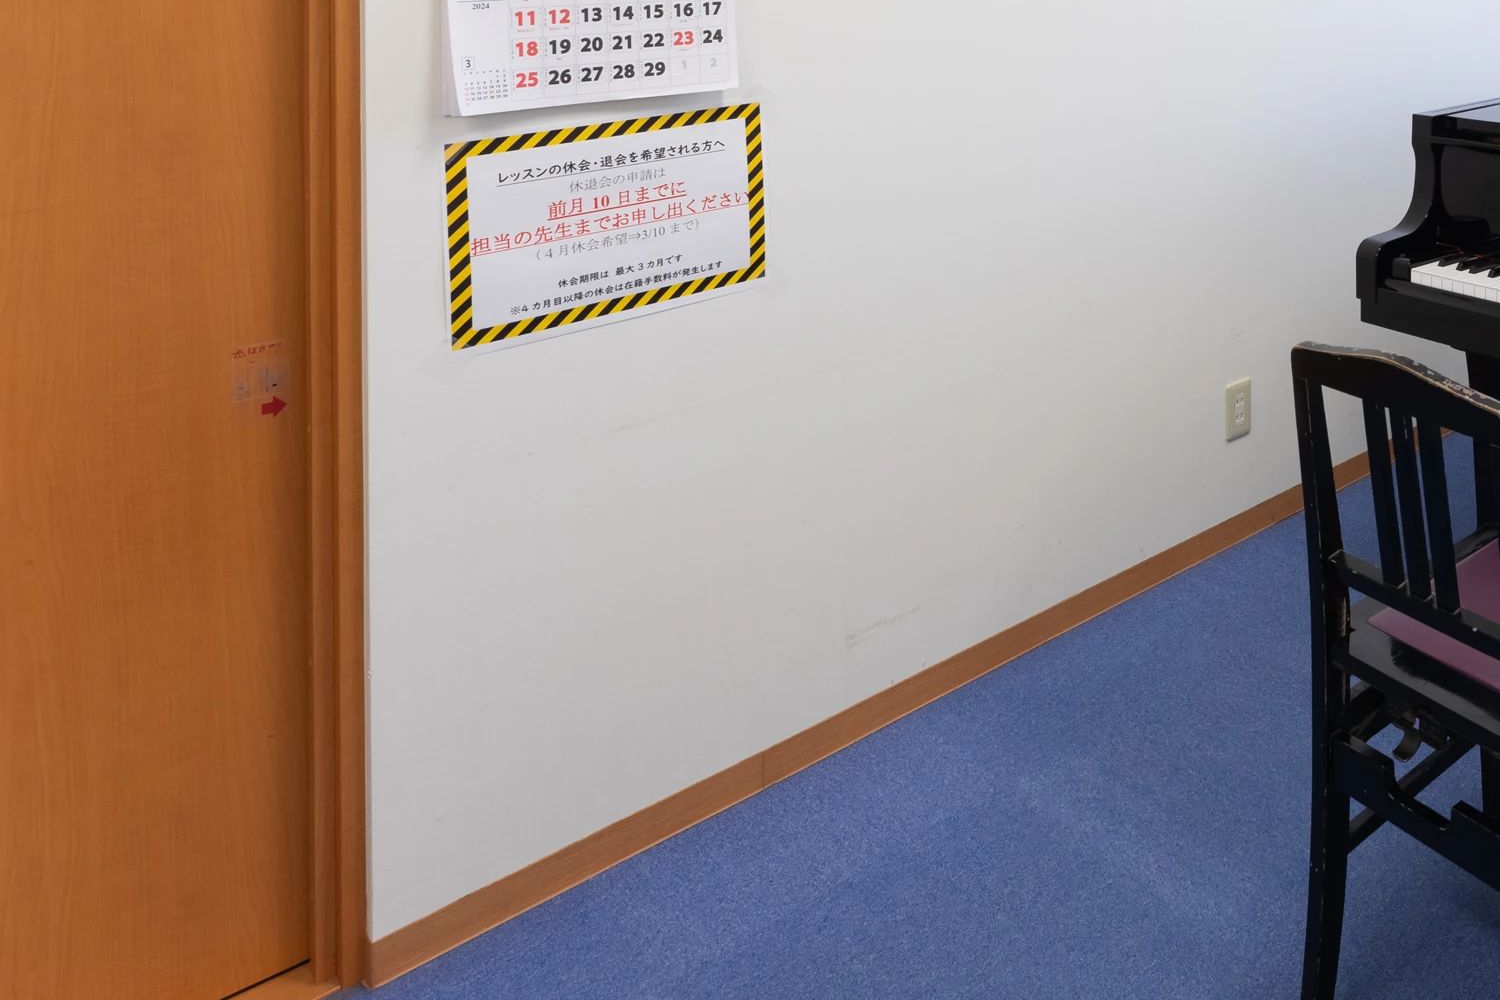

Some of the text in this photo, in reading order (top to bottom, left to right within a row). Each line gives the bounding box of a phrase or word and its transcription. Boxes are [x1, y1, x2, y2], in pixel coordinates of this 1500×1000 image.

[515, 2, 721, 26] 11 12 13 14 15 16 17
[516, 29, 723, 57] 18 19 20 21 22 23 24
[465, 60, 471, 68] 3
[516, 72, 538, 88] 25
[549, 69, 571, 85] 26
[581, 67, 603, 82] 27
[613, 64, 635, 79] 28
[644, 62, 665, 76] 29
[681, 60, 686, 69] 1
[710, 58, 717, 67] 2
[499, 139, 726, 183] レッスンの休会・退会を希望される方へ
[570, 168, 666, 193] 休退会の申請は
